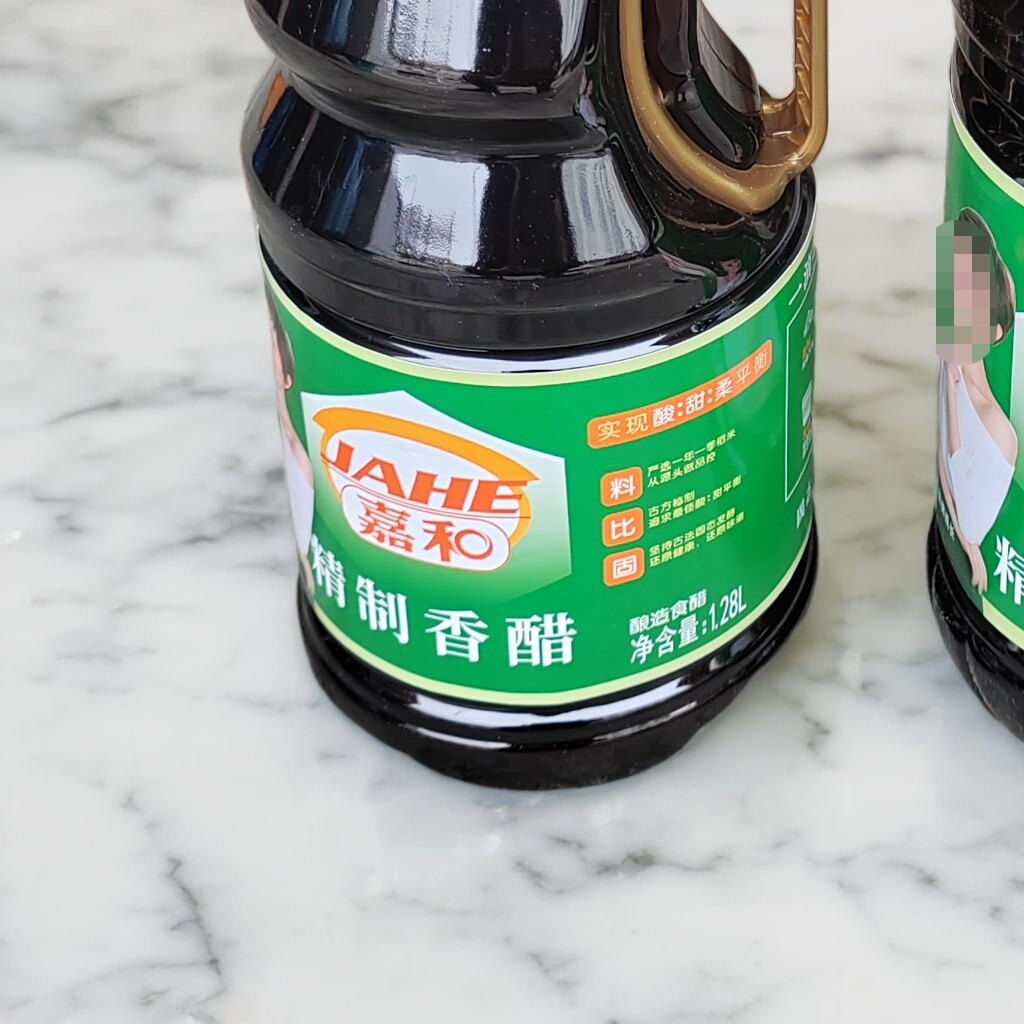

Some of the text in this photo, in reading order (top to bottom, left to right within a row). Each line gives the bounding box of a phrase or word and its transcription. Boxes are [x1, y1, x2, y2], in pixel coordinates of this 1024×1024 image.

[320, 439, 528, 514] JAHE
[609, 474, 636, 500] 料
[357, 493, 494, 563] 嘉和
[611, 516, 637, 541] 比
[612, 554, 638, 580] 固
[308, 533, 578, 668] 精制香醋
[629, 588, 708, 635] 酿造食醋
